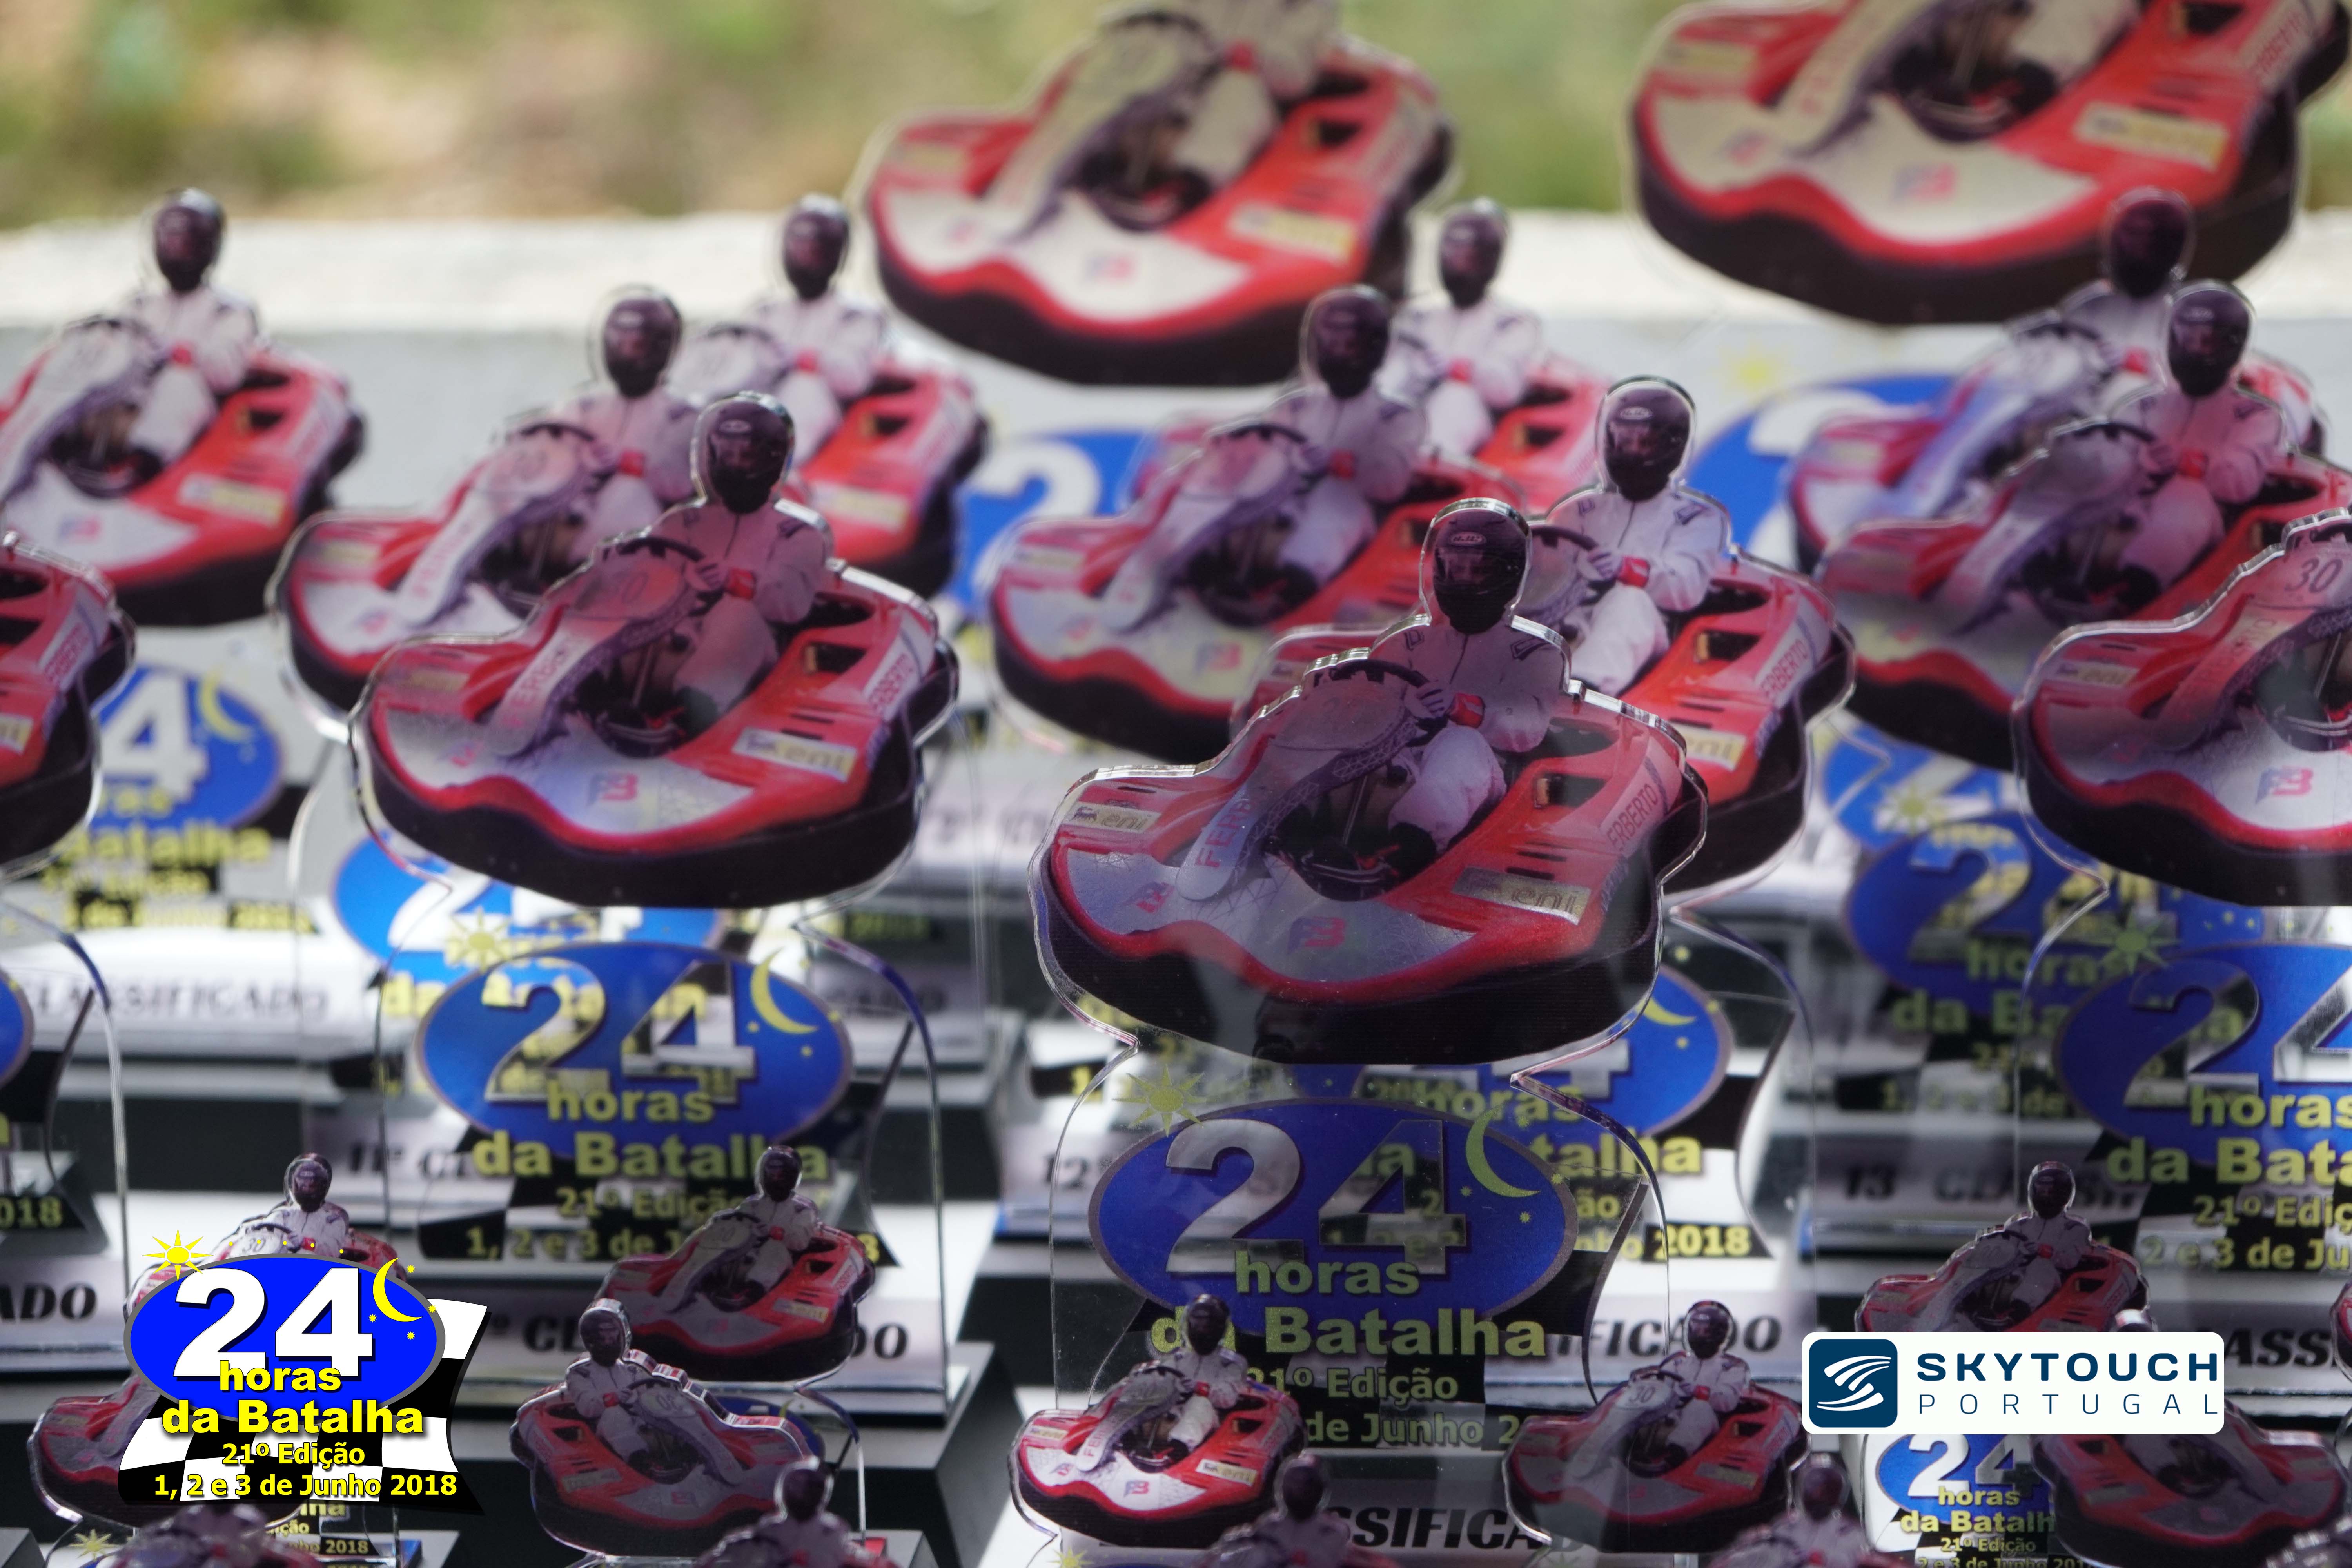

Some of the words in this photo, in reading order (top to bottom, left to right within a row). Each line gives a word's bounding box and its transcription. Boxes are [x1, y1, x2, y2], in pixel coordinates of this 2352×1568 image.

[2286, 559, 2342, 593] 30
[98, 675, 210, 802] 4
[1100, 813, 1149, 830] eni
[1511, 887, 1577, 912] eni
[482, 956, 756, 1104] 24
[550, 1079, 715, 1123] horas
[472, 1130, 552, 1177] da
[2107, 1137, 2189, 1185] da
[0, 1196, 63, 1229] 018
[1165, 1119, 1466, 1274] 24
[2194, 1196, 2261, 1226] 21º
[2276, 1197, 2352, 1233] Ediç
[577, 1229, 599, 1257] 3
[609, 1229, 655, 1256] de
[1654, 1225, 1752, 1258] 2018
[2214, 1237, 2236, 1268] 3
[2247, 1237, 2295, 1269] de
[1235, 1250, 1421, 1295] horas
[1265, 1306, 1546, 1357] Batalha
[1327, 1367, 1459, 1407] Edição
[1308, 1412, 1350, 1443] de
[1361, 1412, 1484, 1445] Junho
[1938, 1486, 2020, 1506] horas
[1900, 1509, 1939, 1533] da
[1951, 1510, 2055, 1533] Batalh
[325, 1539, 369, 1555] 2018
[1941, 1537, 1973, 1552] 21º
[1978, 1537, 2037, 1555] Edição
[2053, 1558, 2092, 1568] 201
